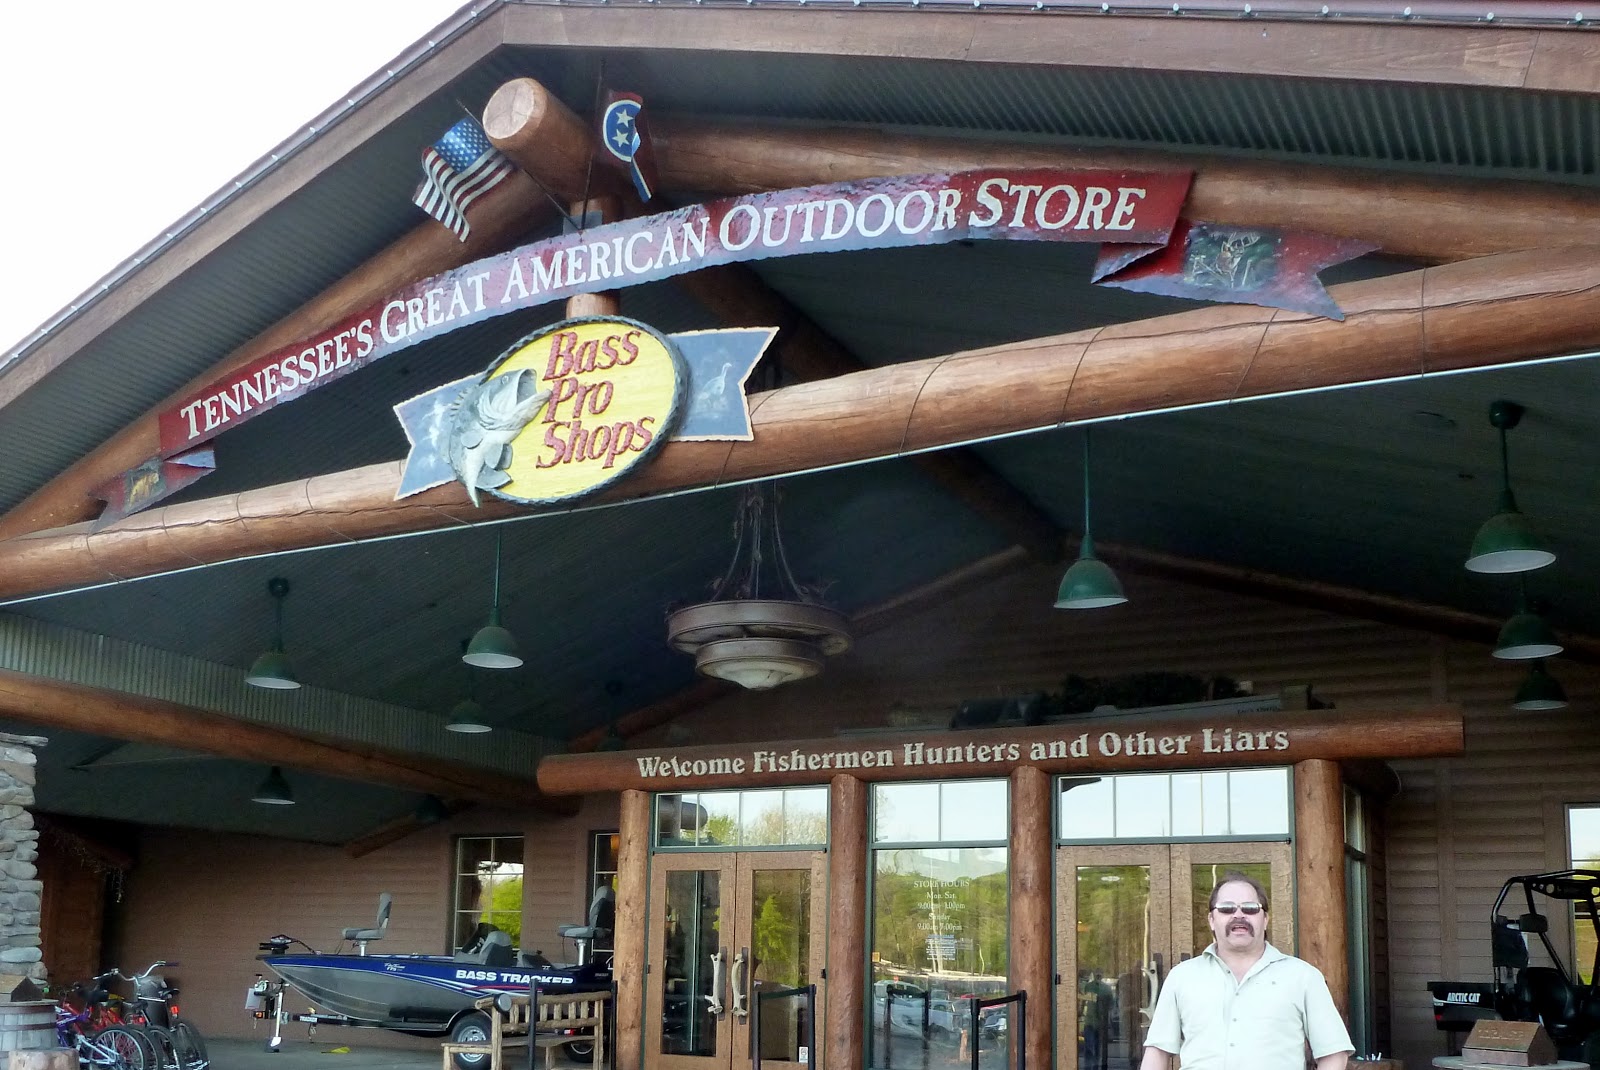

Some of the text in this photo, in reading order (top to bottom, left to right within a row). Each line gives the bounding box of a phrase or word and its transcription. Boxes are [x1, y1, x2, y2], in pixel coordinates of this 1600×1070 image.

[181, 178, 1147, 441] TENNESSEE'S GREAT AMERICAN OUTDOOR STORE
[542, 329, 642, 382] Bass
[542, 378, 614, 425] Pro
[536, 415, 656, 469] Shops
[637, 728, 1290, 778] Welcome Fishermen Hunters and Other Liars
[913, 879, 970, 888] STORE HOURS
[455, 969, 497, 981] BASS
[1447, 992, 1481, 1003] ARCTIC CAT
